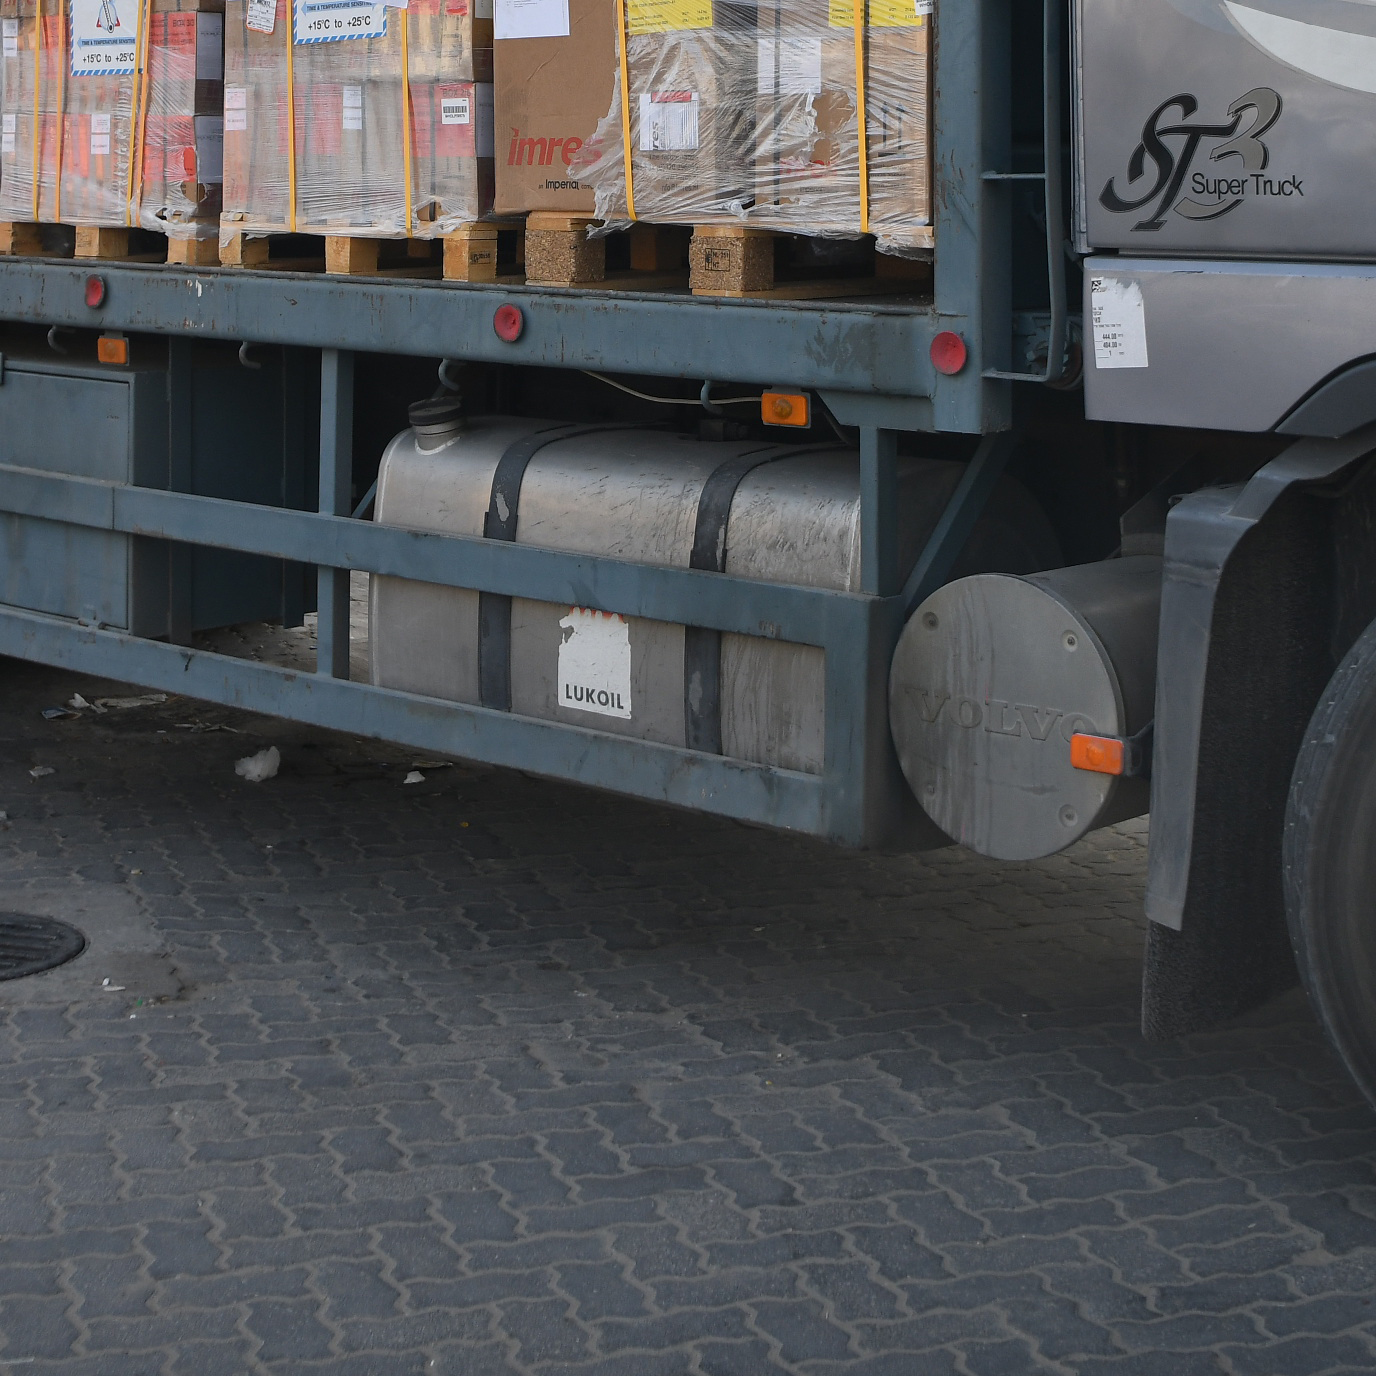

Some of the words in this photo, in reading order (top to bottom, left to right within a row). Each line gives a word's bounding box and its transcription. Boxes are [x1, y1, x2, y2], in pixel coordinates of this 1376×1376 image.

[334, 18, 343, 28] to
[104, 53, 112, 63] to
[507, 126, 604, 166] imres
[1191, 172, 1247, 201] Super
[1250, 173, 1305, 198] Truck
[566, 684, 624, 710] LUKOIL
[905, 686, 1097, 742] VOLVO
